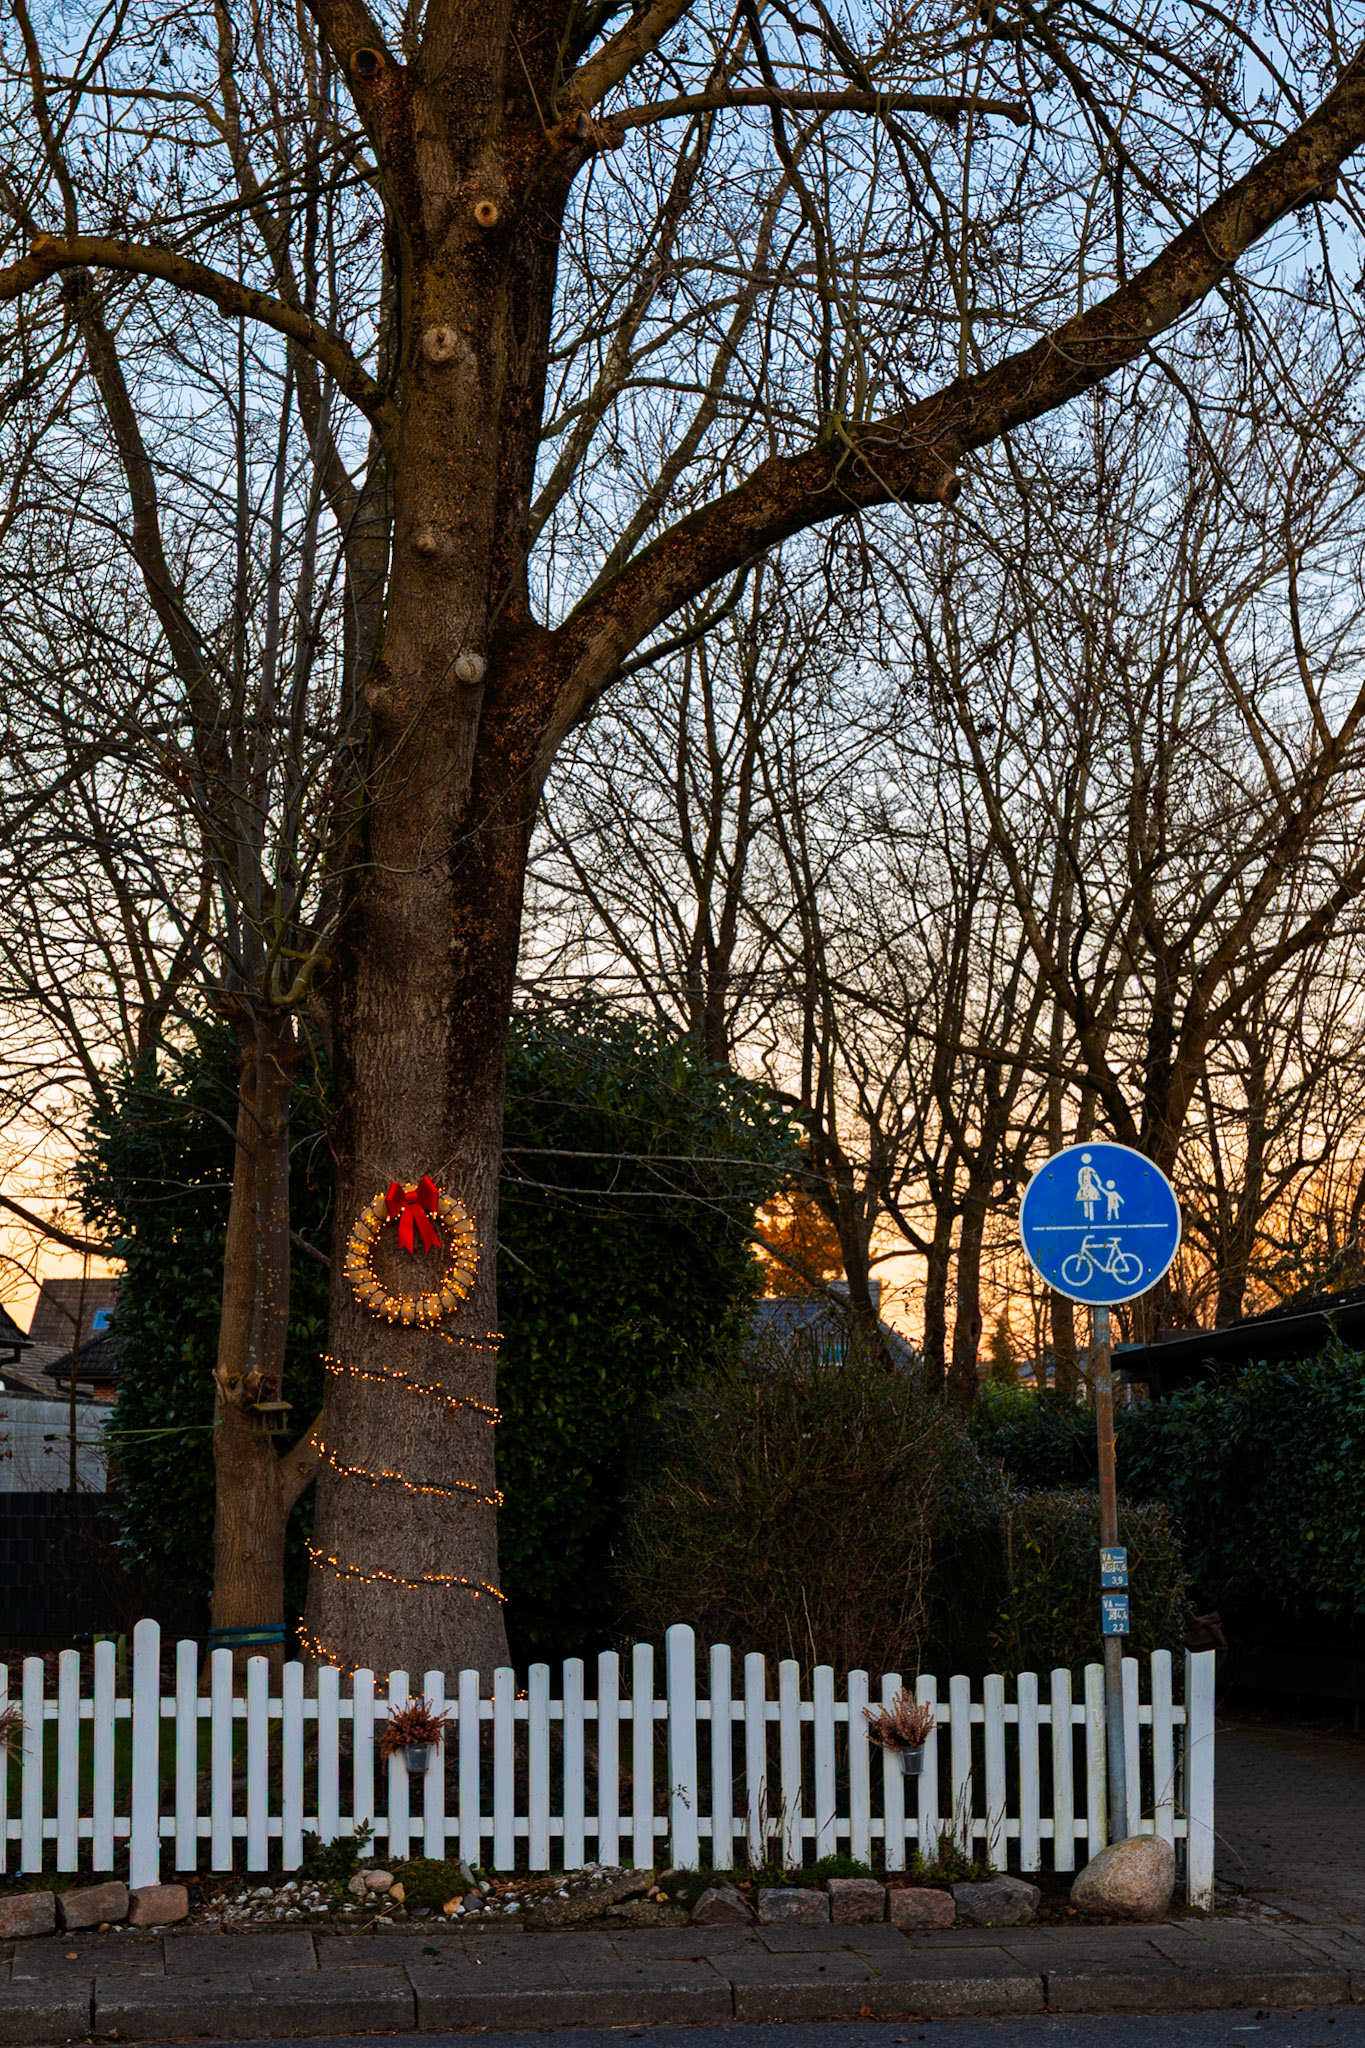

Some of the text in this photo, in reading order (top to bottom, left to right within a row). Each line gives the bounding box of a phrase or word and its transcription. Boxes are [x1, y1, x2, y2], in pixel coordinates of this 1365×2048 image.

[1101, 1553, 1112, 1561] VA
[1103, 1600, 1113, 1608] VA
[1112, 1623, 1124, 1632] 2,2
